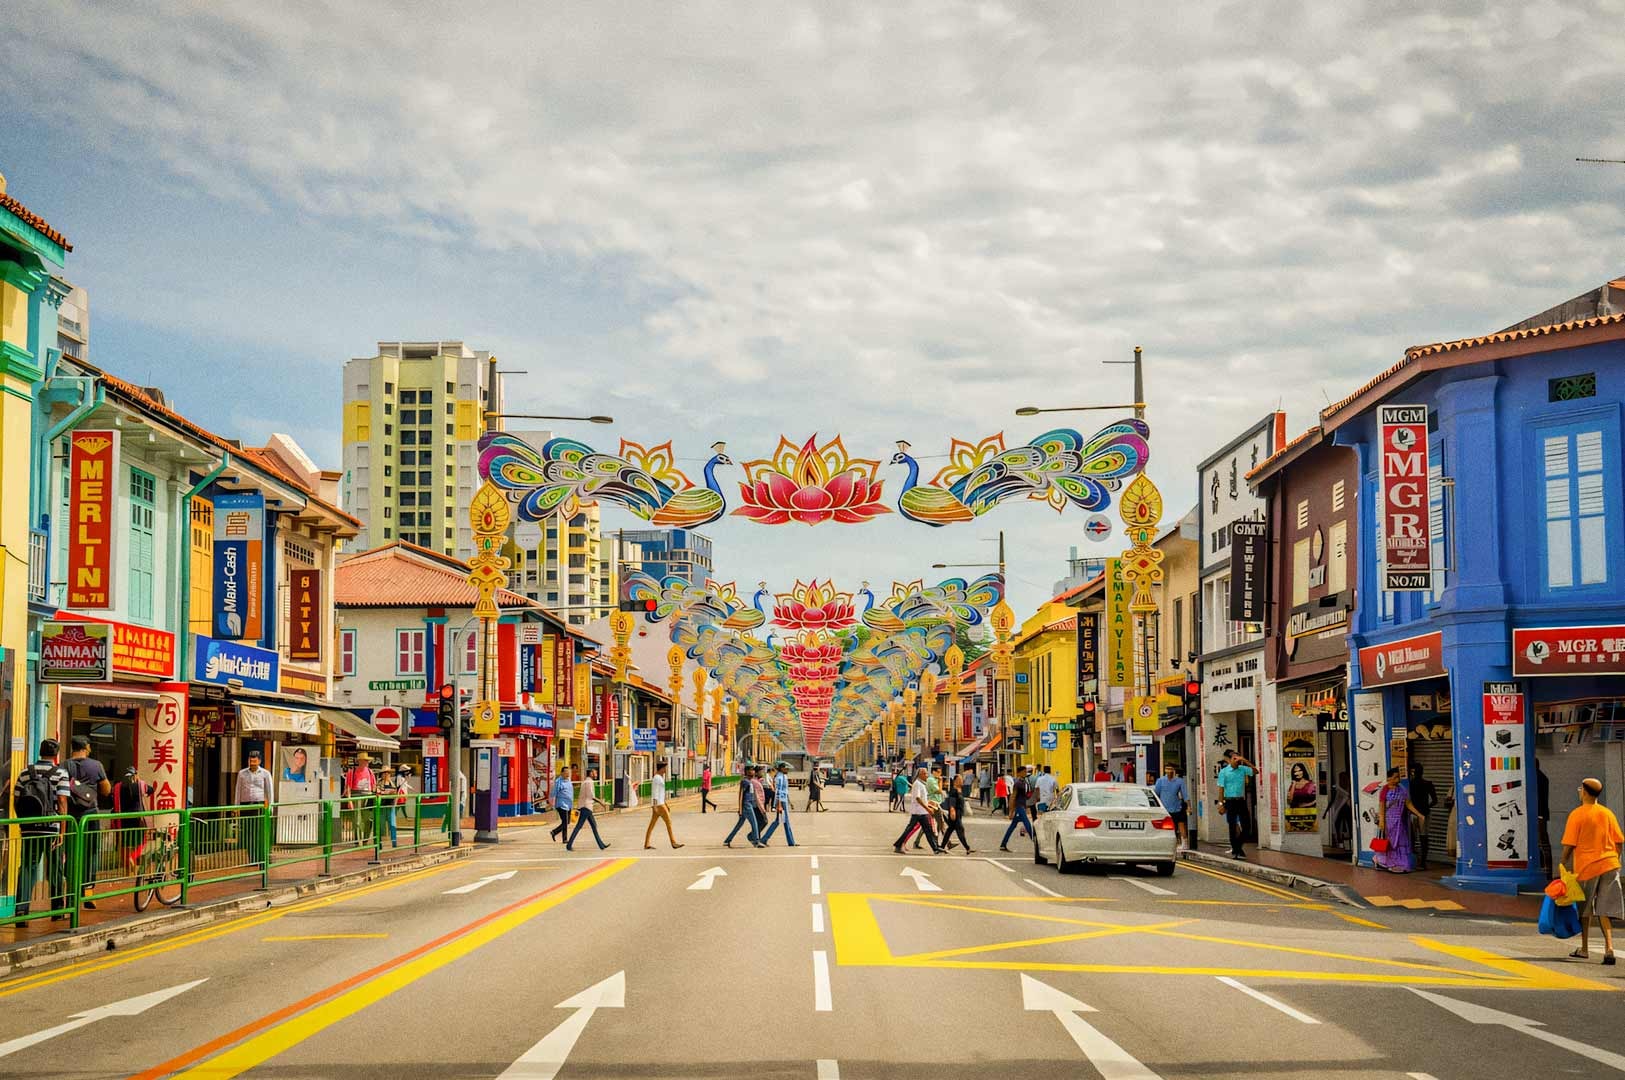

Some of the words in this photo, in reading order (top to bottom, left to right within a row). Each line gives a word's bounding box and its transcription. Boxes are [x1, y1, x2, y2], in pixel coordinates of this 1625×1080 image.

[1384, 409, 1425, 423] MGM
[77, 460, 104, 588] MERLIN
[1384, 452, 1425, 538] MGR
[223, 547, 237, 612] Maxi-Cash
[1243, 536, 1254, 618] JEWELLERS
[300, 576, 311, 649] SATYA
[42, 645, 106, 658] ANIMANI
[1115, 629, 1125, 682] VILAS
[1557, 639, 1598, 653] MGR
[153, 703, 177, 726] 75
